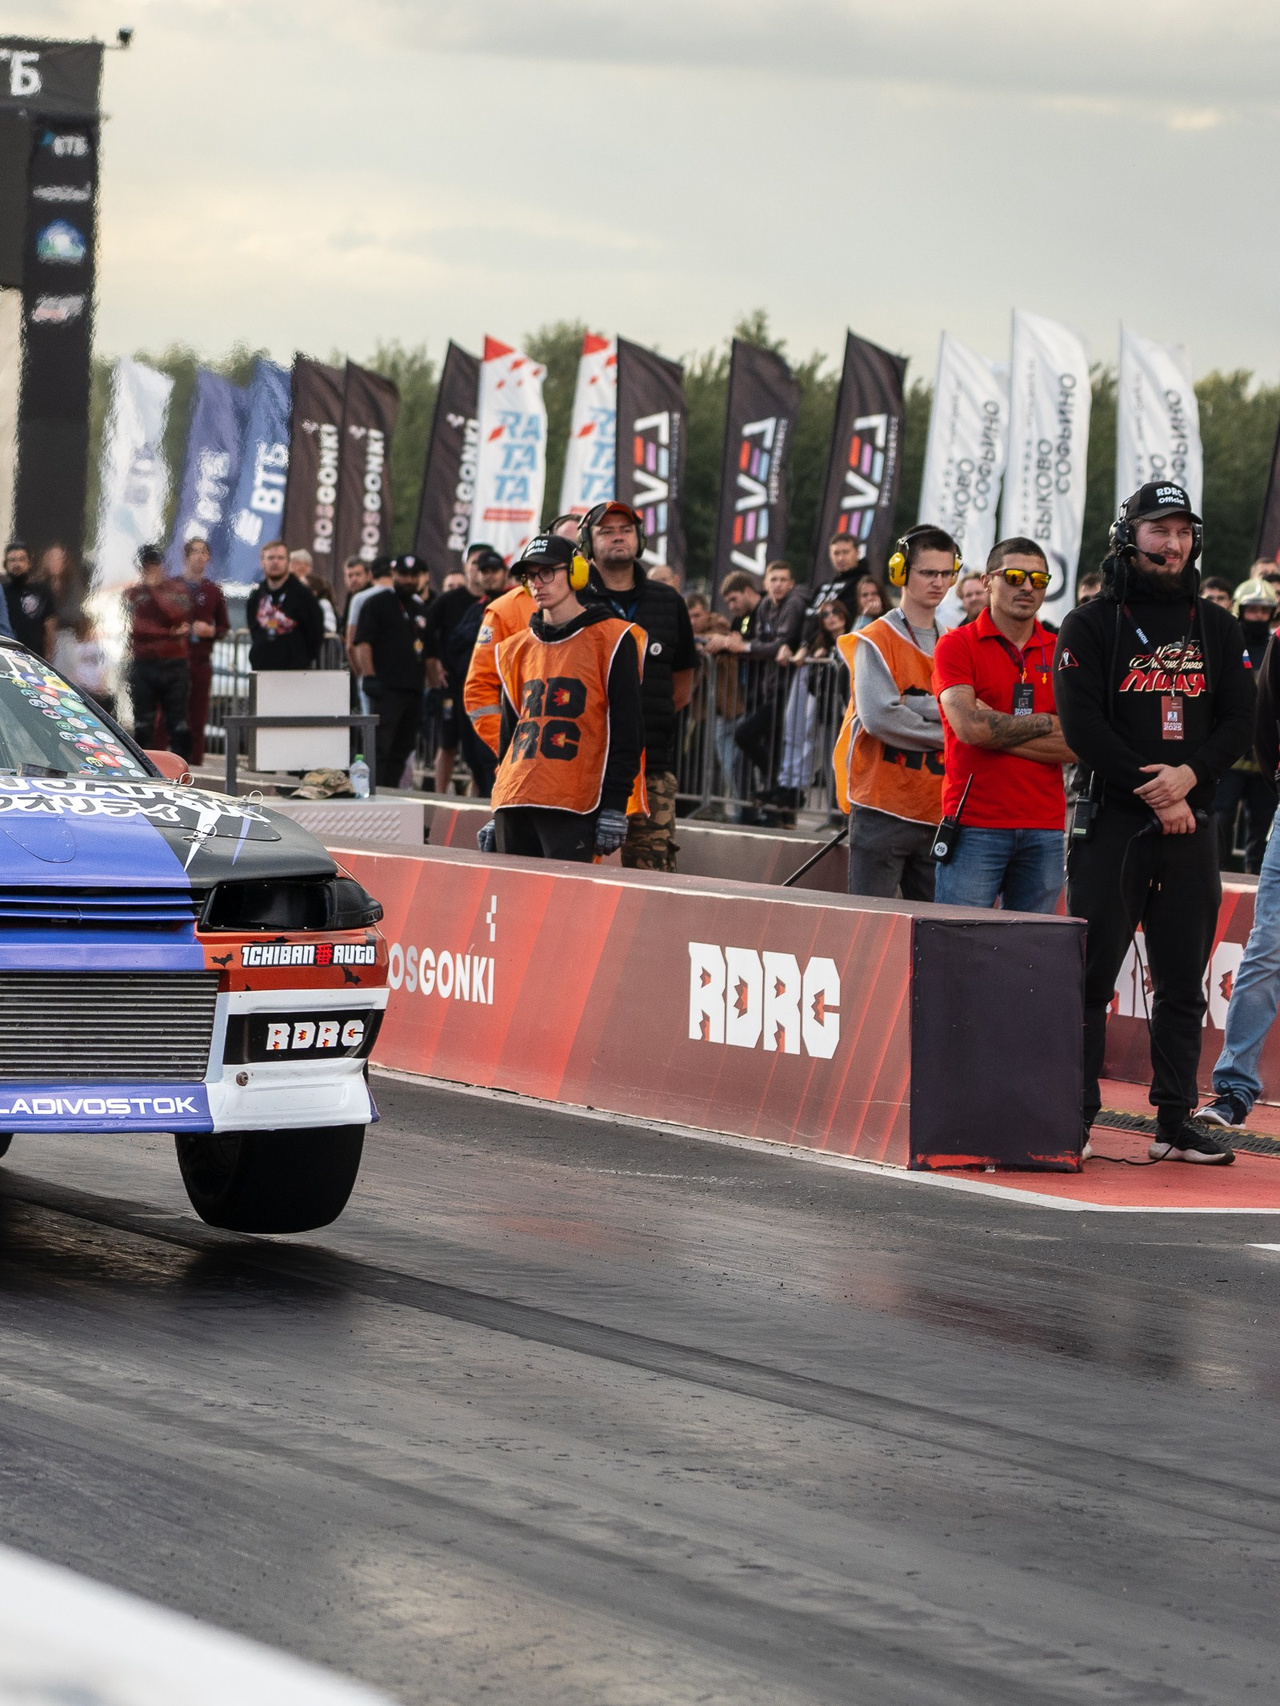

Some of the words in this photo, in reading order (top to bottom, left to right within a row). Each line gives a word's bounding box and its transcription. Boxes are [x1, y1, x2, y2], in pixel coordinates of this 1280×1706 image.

[250, 439, 290, 514] ВТБ
[974, 400, 1000, 512] СОФЬИНО
[1055, 373, 1078, 494] СОФЬИНО
[1165, 389, 1189, 490] ОФЬИНО
[313, 423, 339, 554] ROSGONKI
[951, 457, 975, 541] ЫКОВО
[1034, 438, 1053, 541] БЫКОВО
[1156, 487, 1184, 498] RDRC
[388, 942, 495, 1005] OSGONKI
[688, 942, 841, 1060] RDRC
[265, 1020, 364, 1051] RDRC
